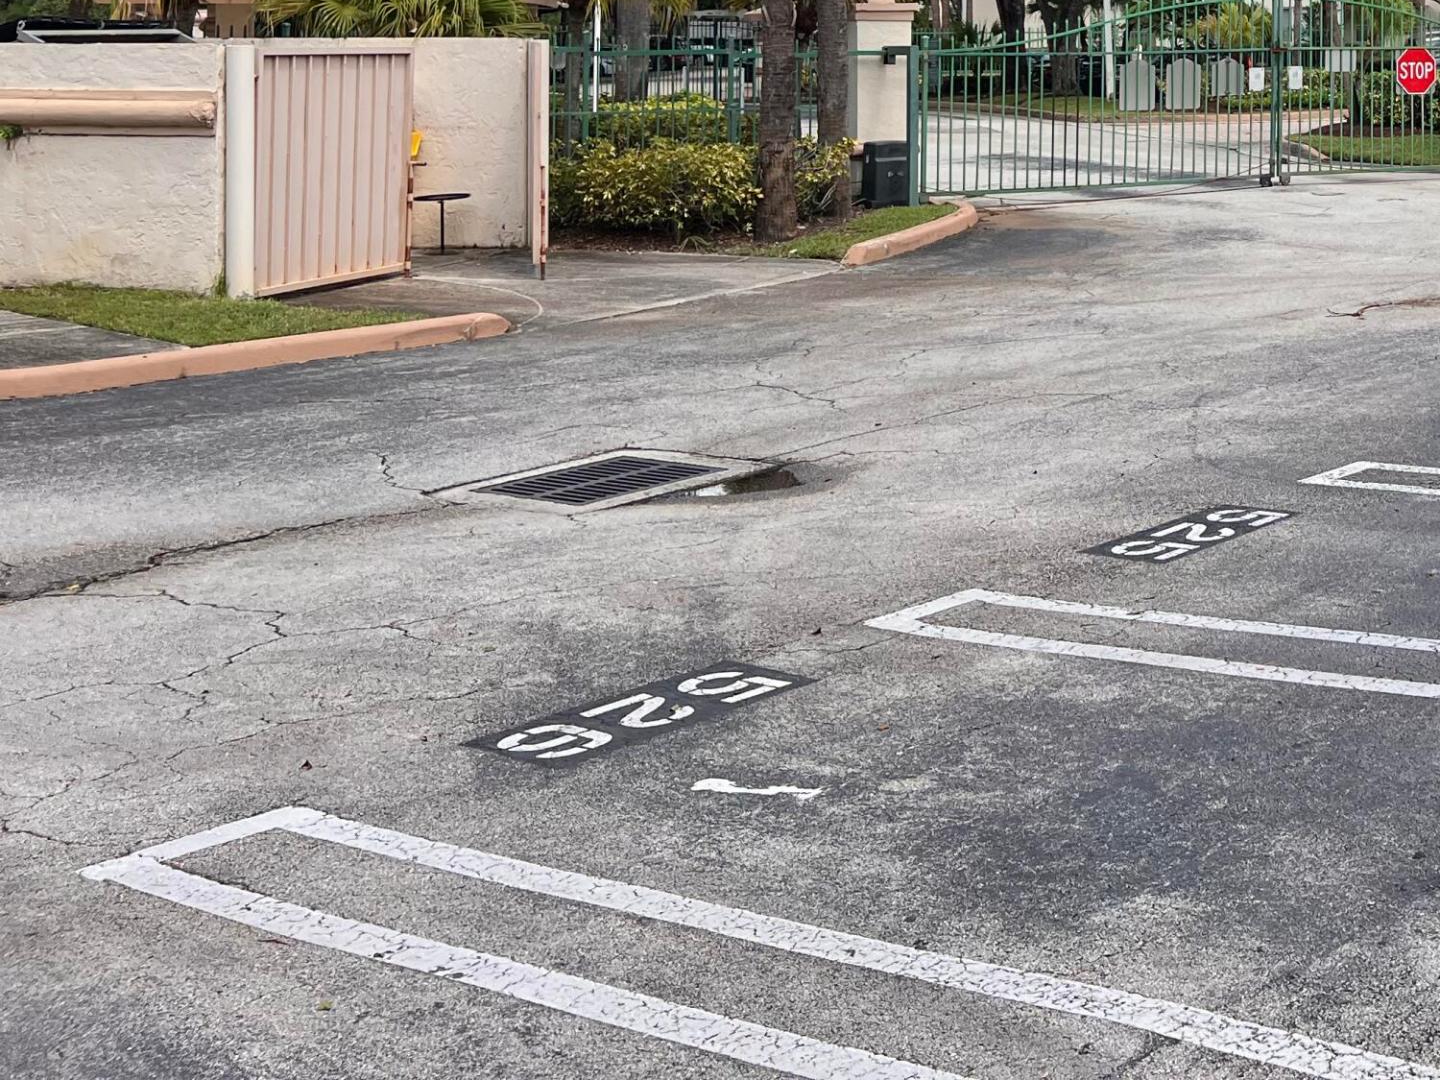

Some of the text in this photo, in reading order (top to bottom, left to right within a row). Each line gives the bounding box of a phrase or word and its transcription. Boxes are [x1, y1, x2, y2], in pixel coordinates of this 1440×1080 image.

[1400, 62, 1433, 79] STOP
[1111, 509, 1289, 560] 525
[497, 671, 792, 758] 526
